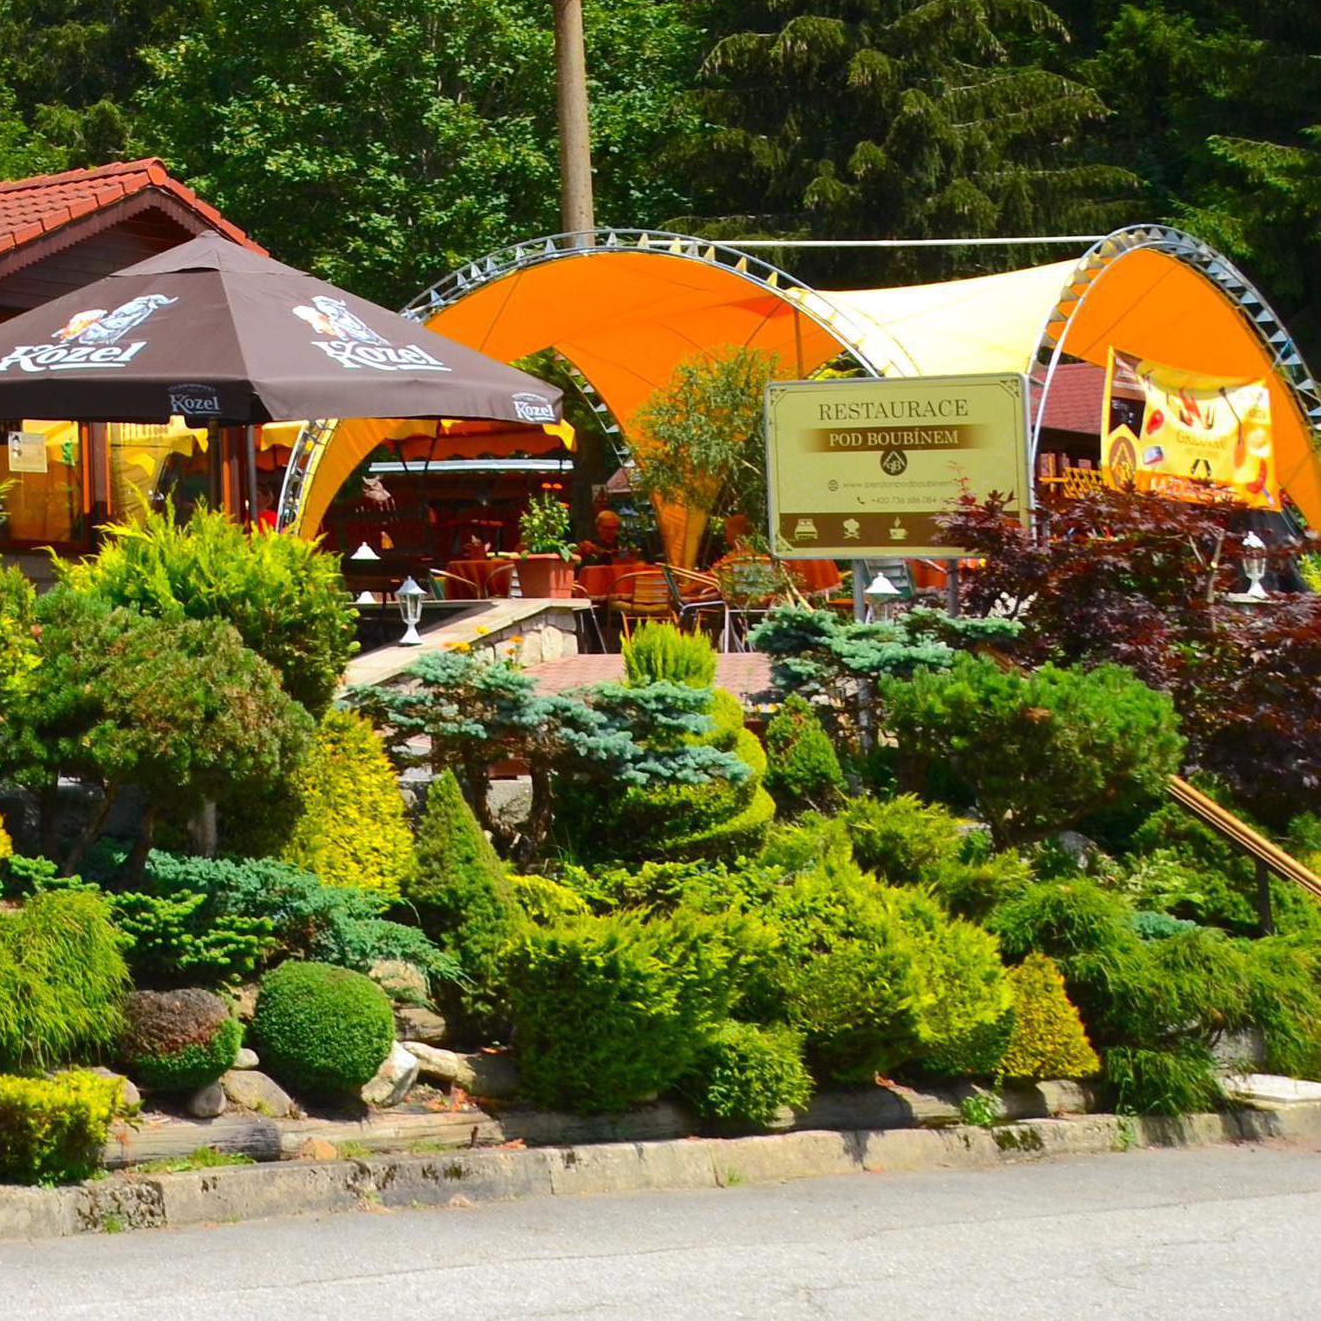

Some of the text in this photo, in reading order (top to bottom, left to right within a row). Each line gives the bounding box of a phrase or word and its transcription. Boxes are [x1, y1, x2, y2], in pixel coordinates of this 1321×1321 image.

[310, 340, 449, 371] Kozel
[170, 393, 220, 414] Kozel
[513, 401, 555, 422] Kozel
[819, 398, 969, 421] RESTAURACE
[829, 428, 959, 447] POD BOUBÍNEM
